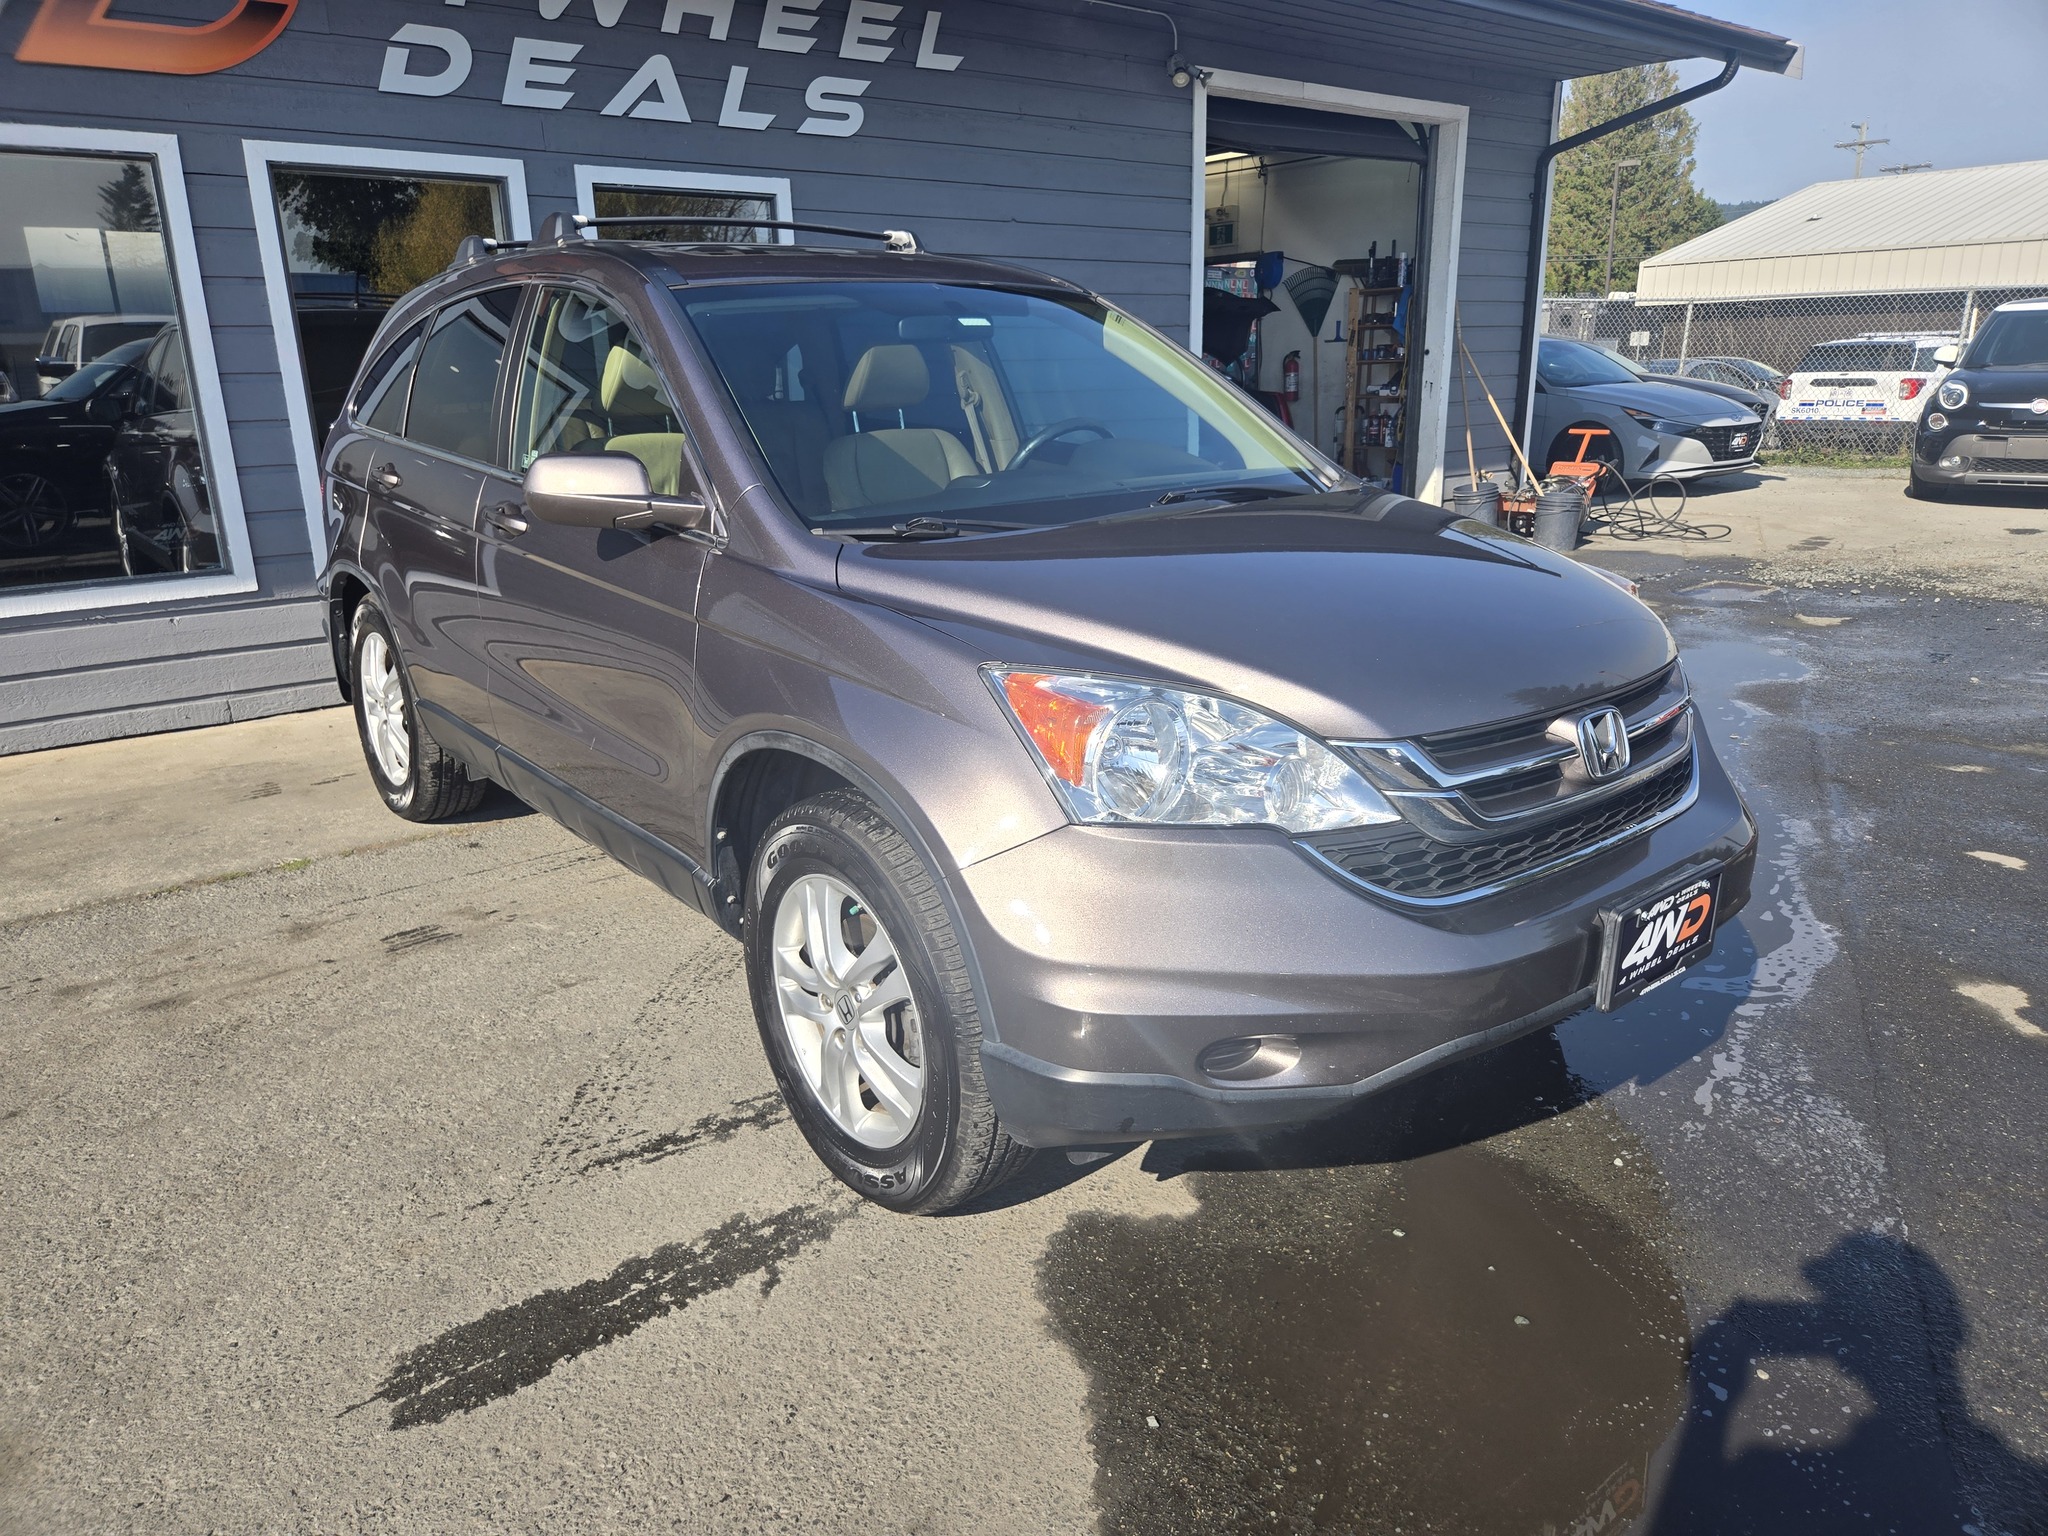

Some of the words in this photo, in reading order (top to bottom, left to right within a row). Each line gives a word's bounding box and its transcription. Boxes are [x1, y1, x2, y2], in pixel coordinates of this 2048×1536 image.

[378, 23, 872, 138] DEALS
[1619, 976, 1627, 986] 4
[1629, 956, 1662, 980] WHEEL
[1666, 935, 1699, 959] DEALS
[1621, 893, 1711, 970] 4WD
